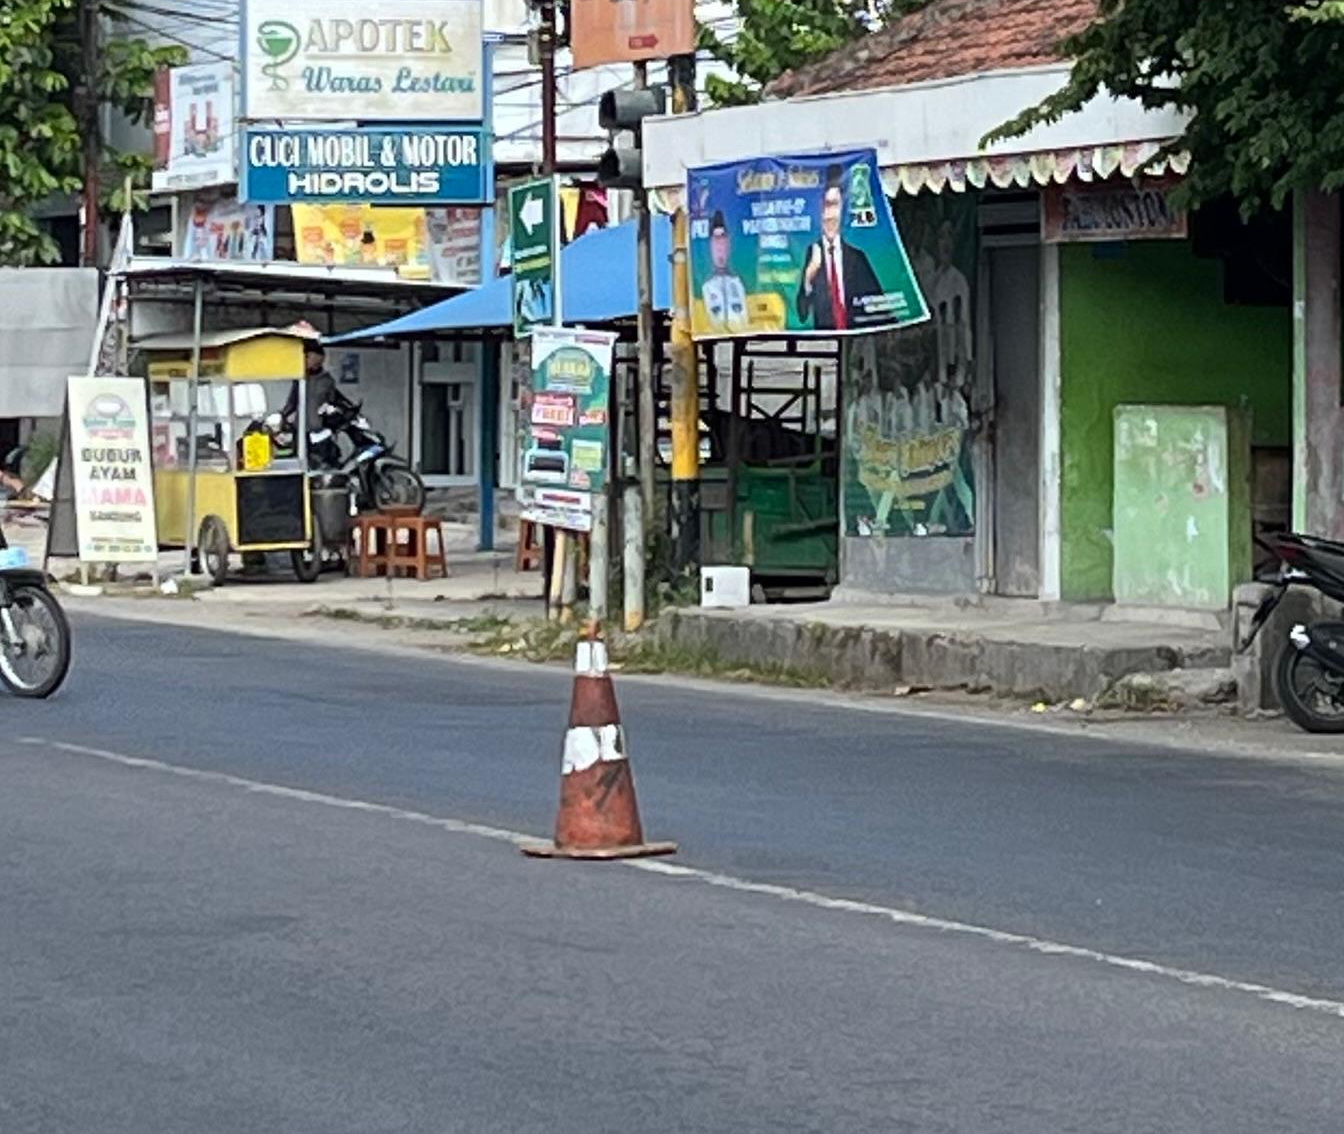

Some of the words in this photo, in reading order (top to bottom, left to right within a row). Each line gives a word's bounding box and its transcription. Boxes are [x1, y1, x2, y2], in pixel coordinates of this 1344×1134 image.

[304, 19, 452, 53] APOTEK
[302, 66, 383, 94] Waras
[392, 66, 476, 94] Lestari
[250, 135, 300, 167] CUCI
[308, 135, 375, 167] MOBIL
[380, 137, 397, 166] &
[402, 135, 477, 166] MOTOR
[288, 171, 440, 195] HIDROLIS
[81, 448, 142, 463] BUBUR
[89, 466, 137, 481] AYAM
